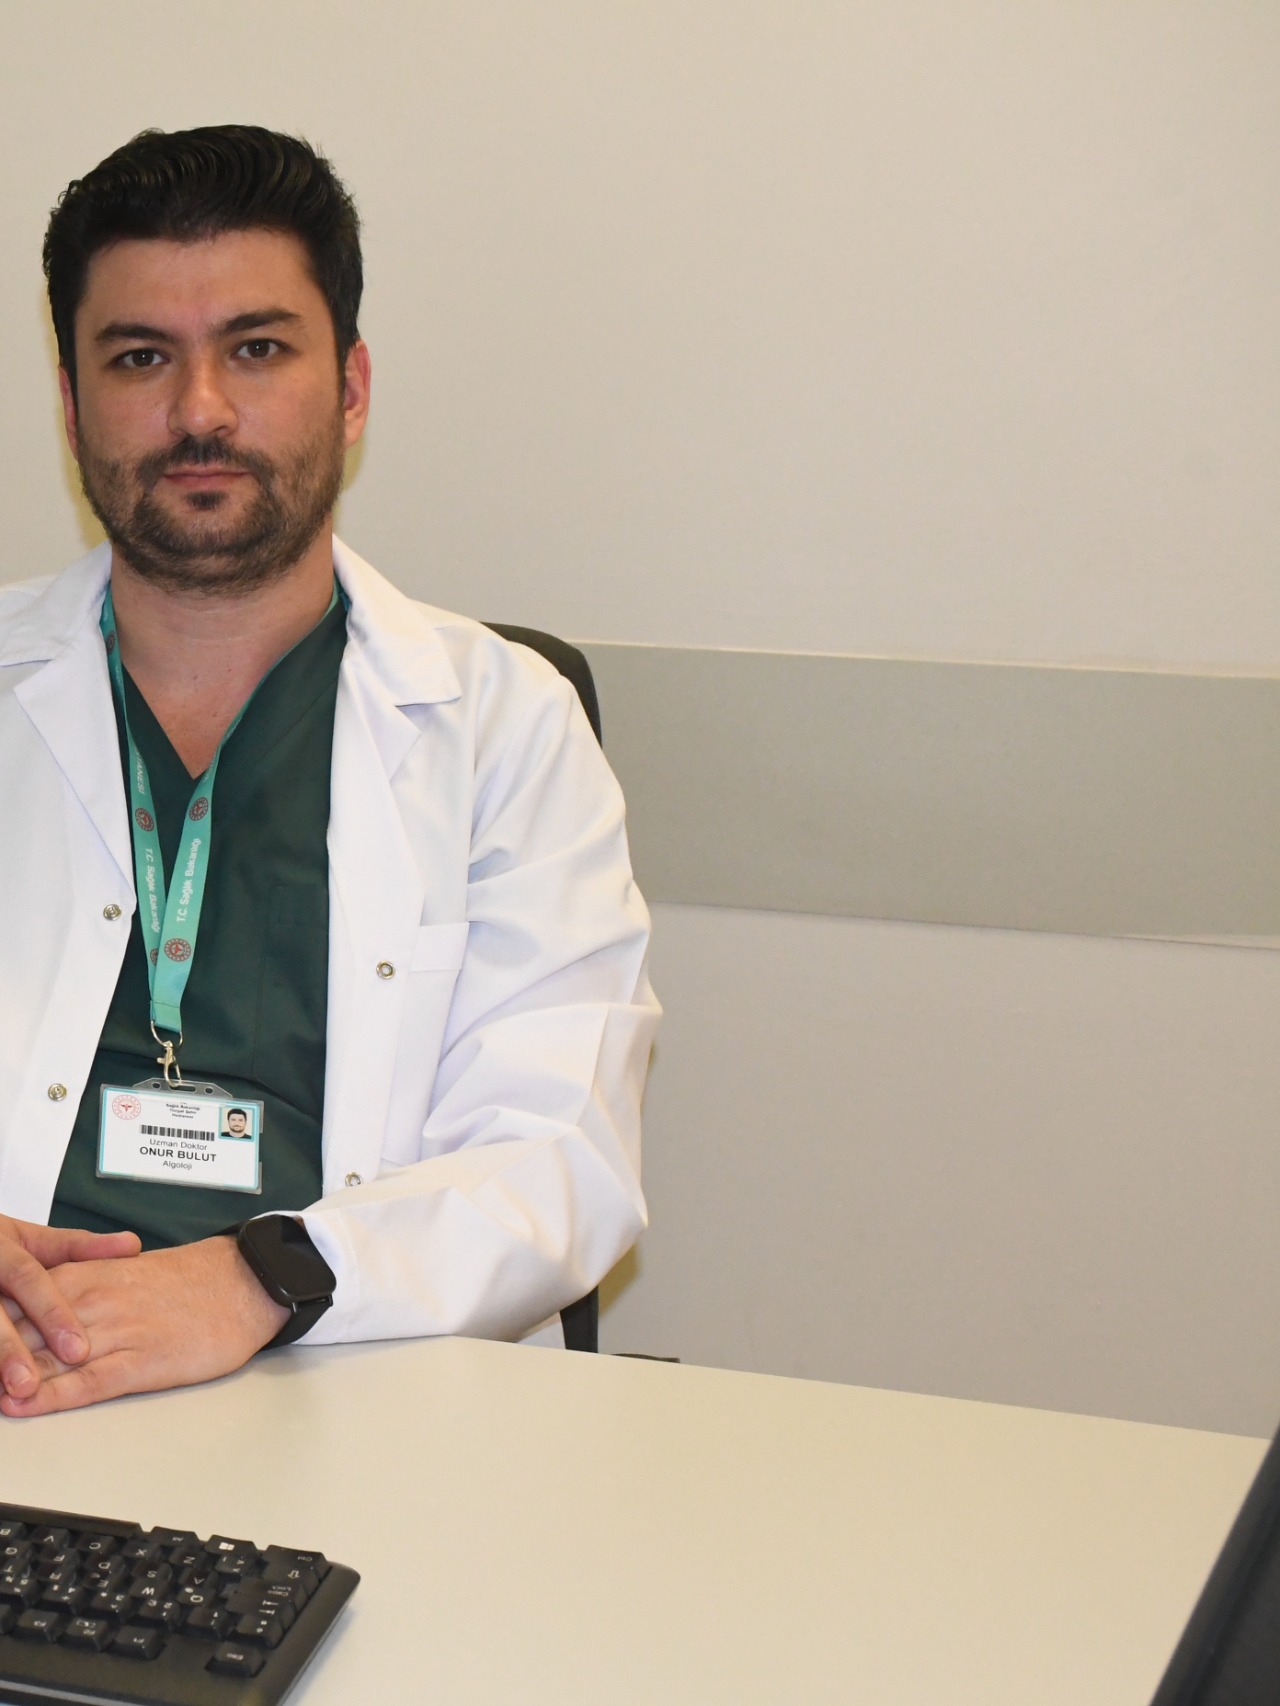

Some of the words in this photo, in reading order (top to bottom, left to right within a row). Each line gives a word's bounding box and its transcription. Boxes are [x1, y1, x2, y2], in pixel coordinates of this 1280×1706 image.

[149, 1139, 178, 1147] Uzman
[180, 1141, 208, 1151] Doktor
[140, 1146, 174, 1158] ONUR
[177, 1150, 217, 1162] BULUT
[163, 1160, 192, 1170] Algoloji
